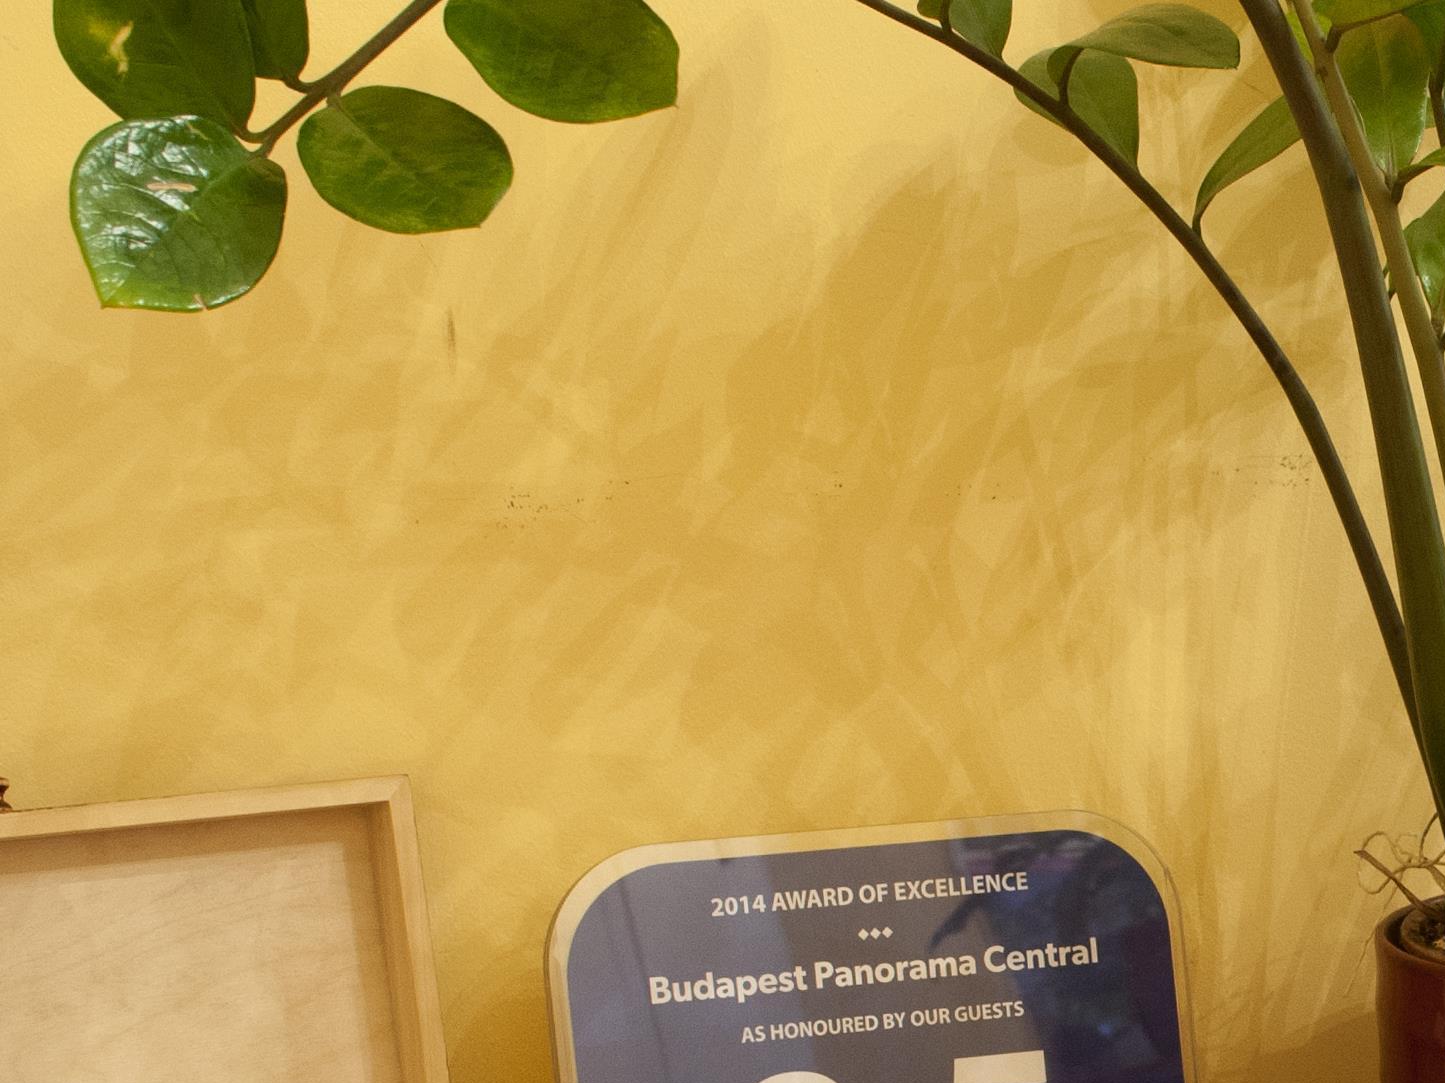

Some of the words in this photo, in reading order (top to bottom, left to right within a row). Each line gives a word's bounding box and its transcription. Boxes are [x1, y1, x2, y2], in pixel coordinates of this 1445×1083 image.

[710, 897, 766, 918] 2014
[771, 885, 854, 913] AWARD
[858, 882, 889, 904] OF
[894, 871, 1029, 901] EXCELLENCE
[649, 964, 808, 1005] Budapest
[814, 952, 977, 989] Panorama
[983, 937, 1099, 973] Central
[741, 1026, 766, 1044] AS
[770, 1014, 879, 1041] HONOURED
[882, 1011, 906, 1029] BY
[910, 1007, 951, 1027] OUR
[954, 1000, 1026, 1024] GUESTS
